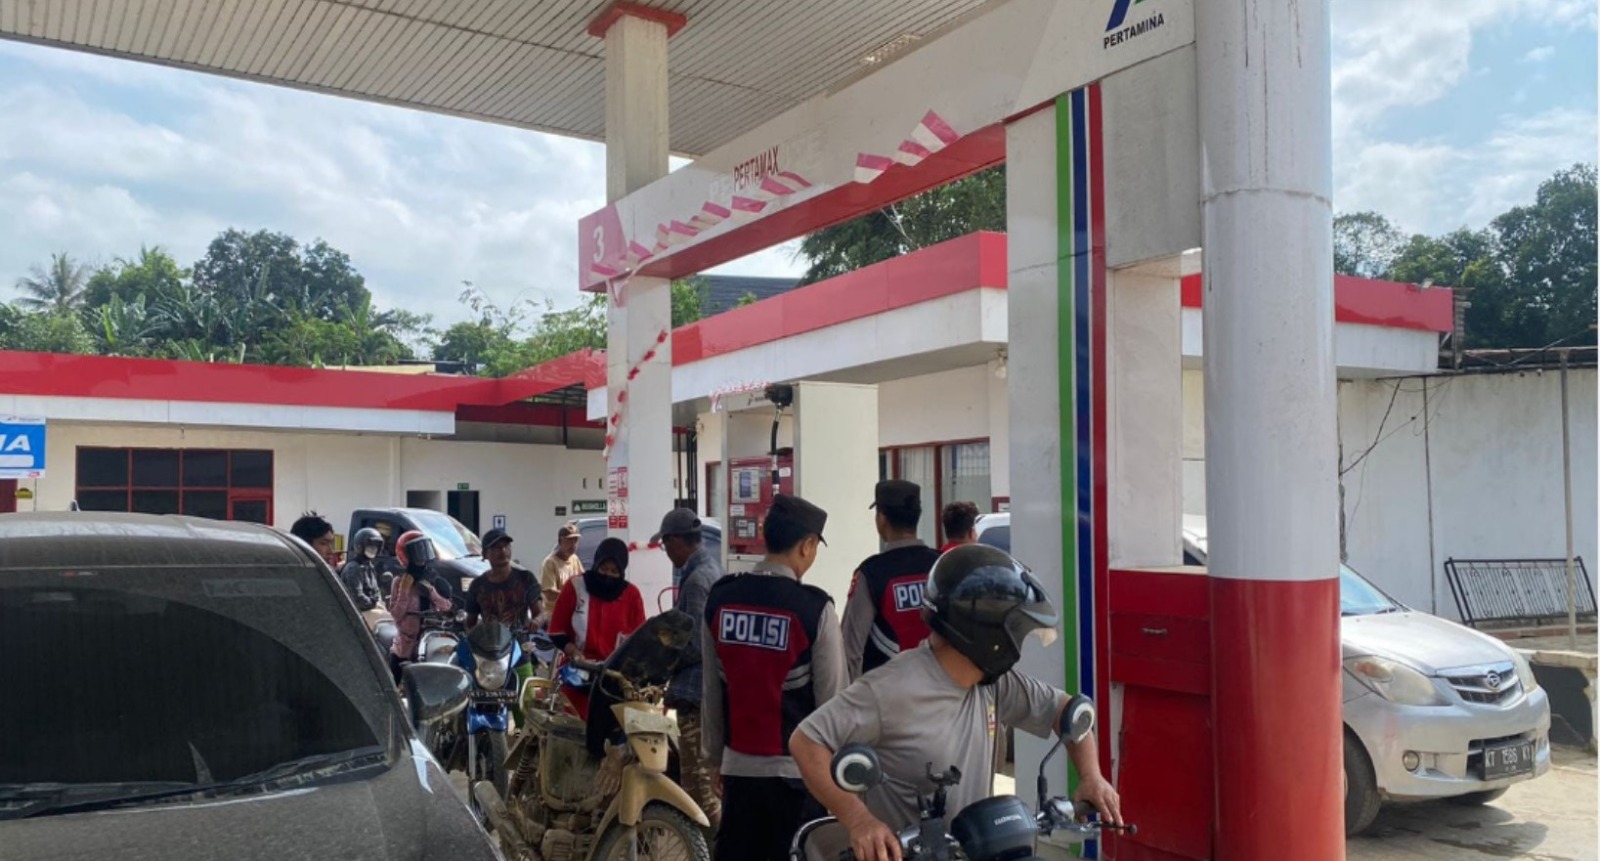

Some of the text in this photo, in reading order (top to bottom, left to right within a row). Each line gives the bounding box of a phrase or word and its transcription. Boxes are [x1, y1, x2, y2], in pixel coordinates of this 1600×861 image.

[1103, 13, 1164, 49] PERTAMINA
[733, 145, 779, 192] PERTAMAX
[593, 225, 604, 263] 3
[722, 613, 787, 647] POLISI
